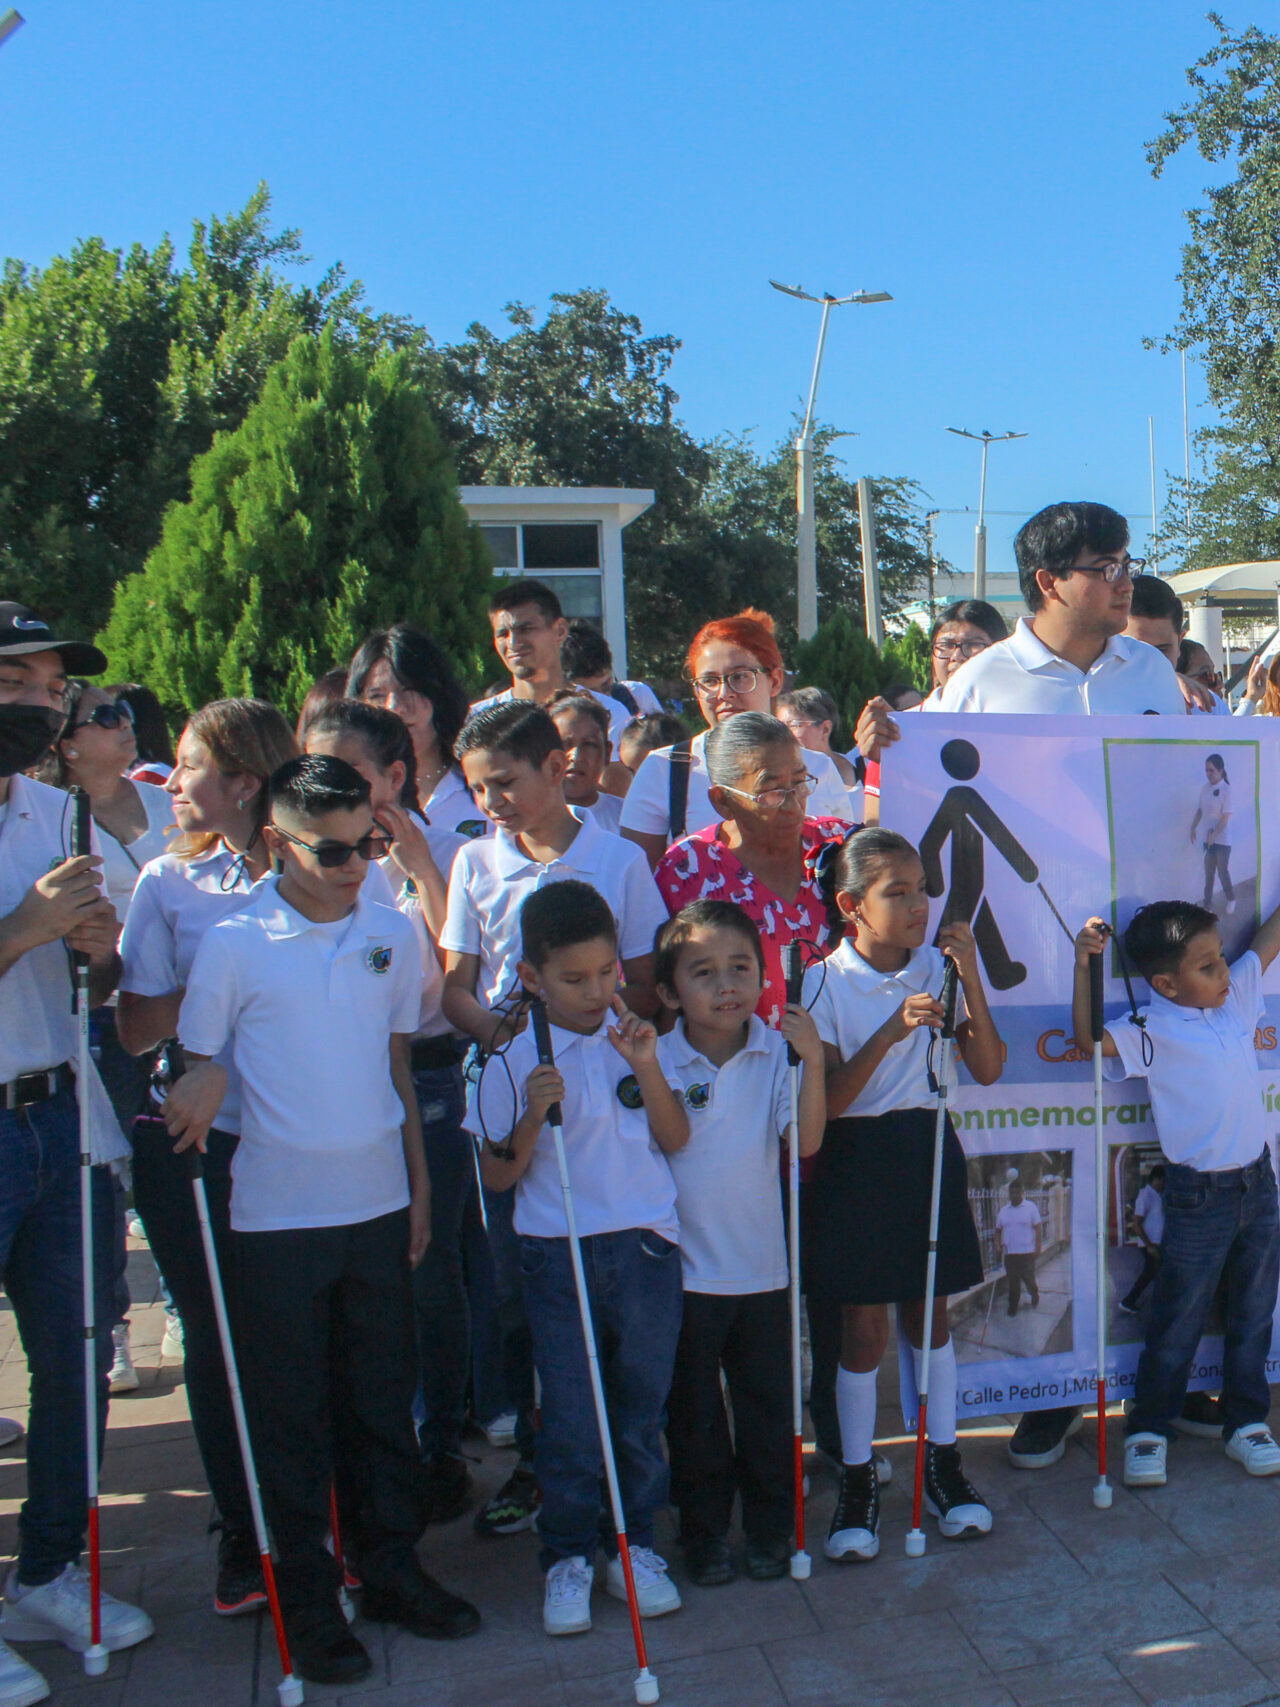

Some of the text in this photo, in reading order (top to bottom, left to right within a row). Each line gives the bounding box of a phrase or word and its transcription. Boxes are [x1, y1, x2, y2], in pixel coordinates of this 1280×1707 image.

[1254, 1026, 1278, 1050] as
[949, 1102, 1155, 1131] onmemoran
[962, 1387, 1004, 1406] Calle
[1009, 1382, 1059, 1401] Pedro
